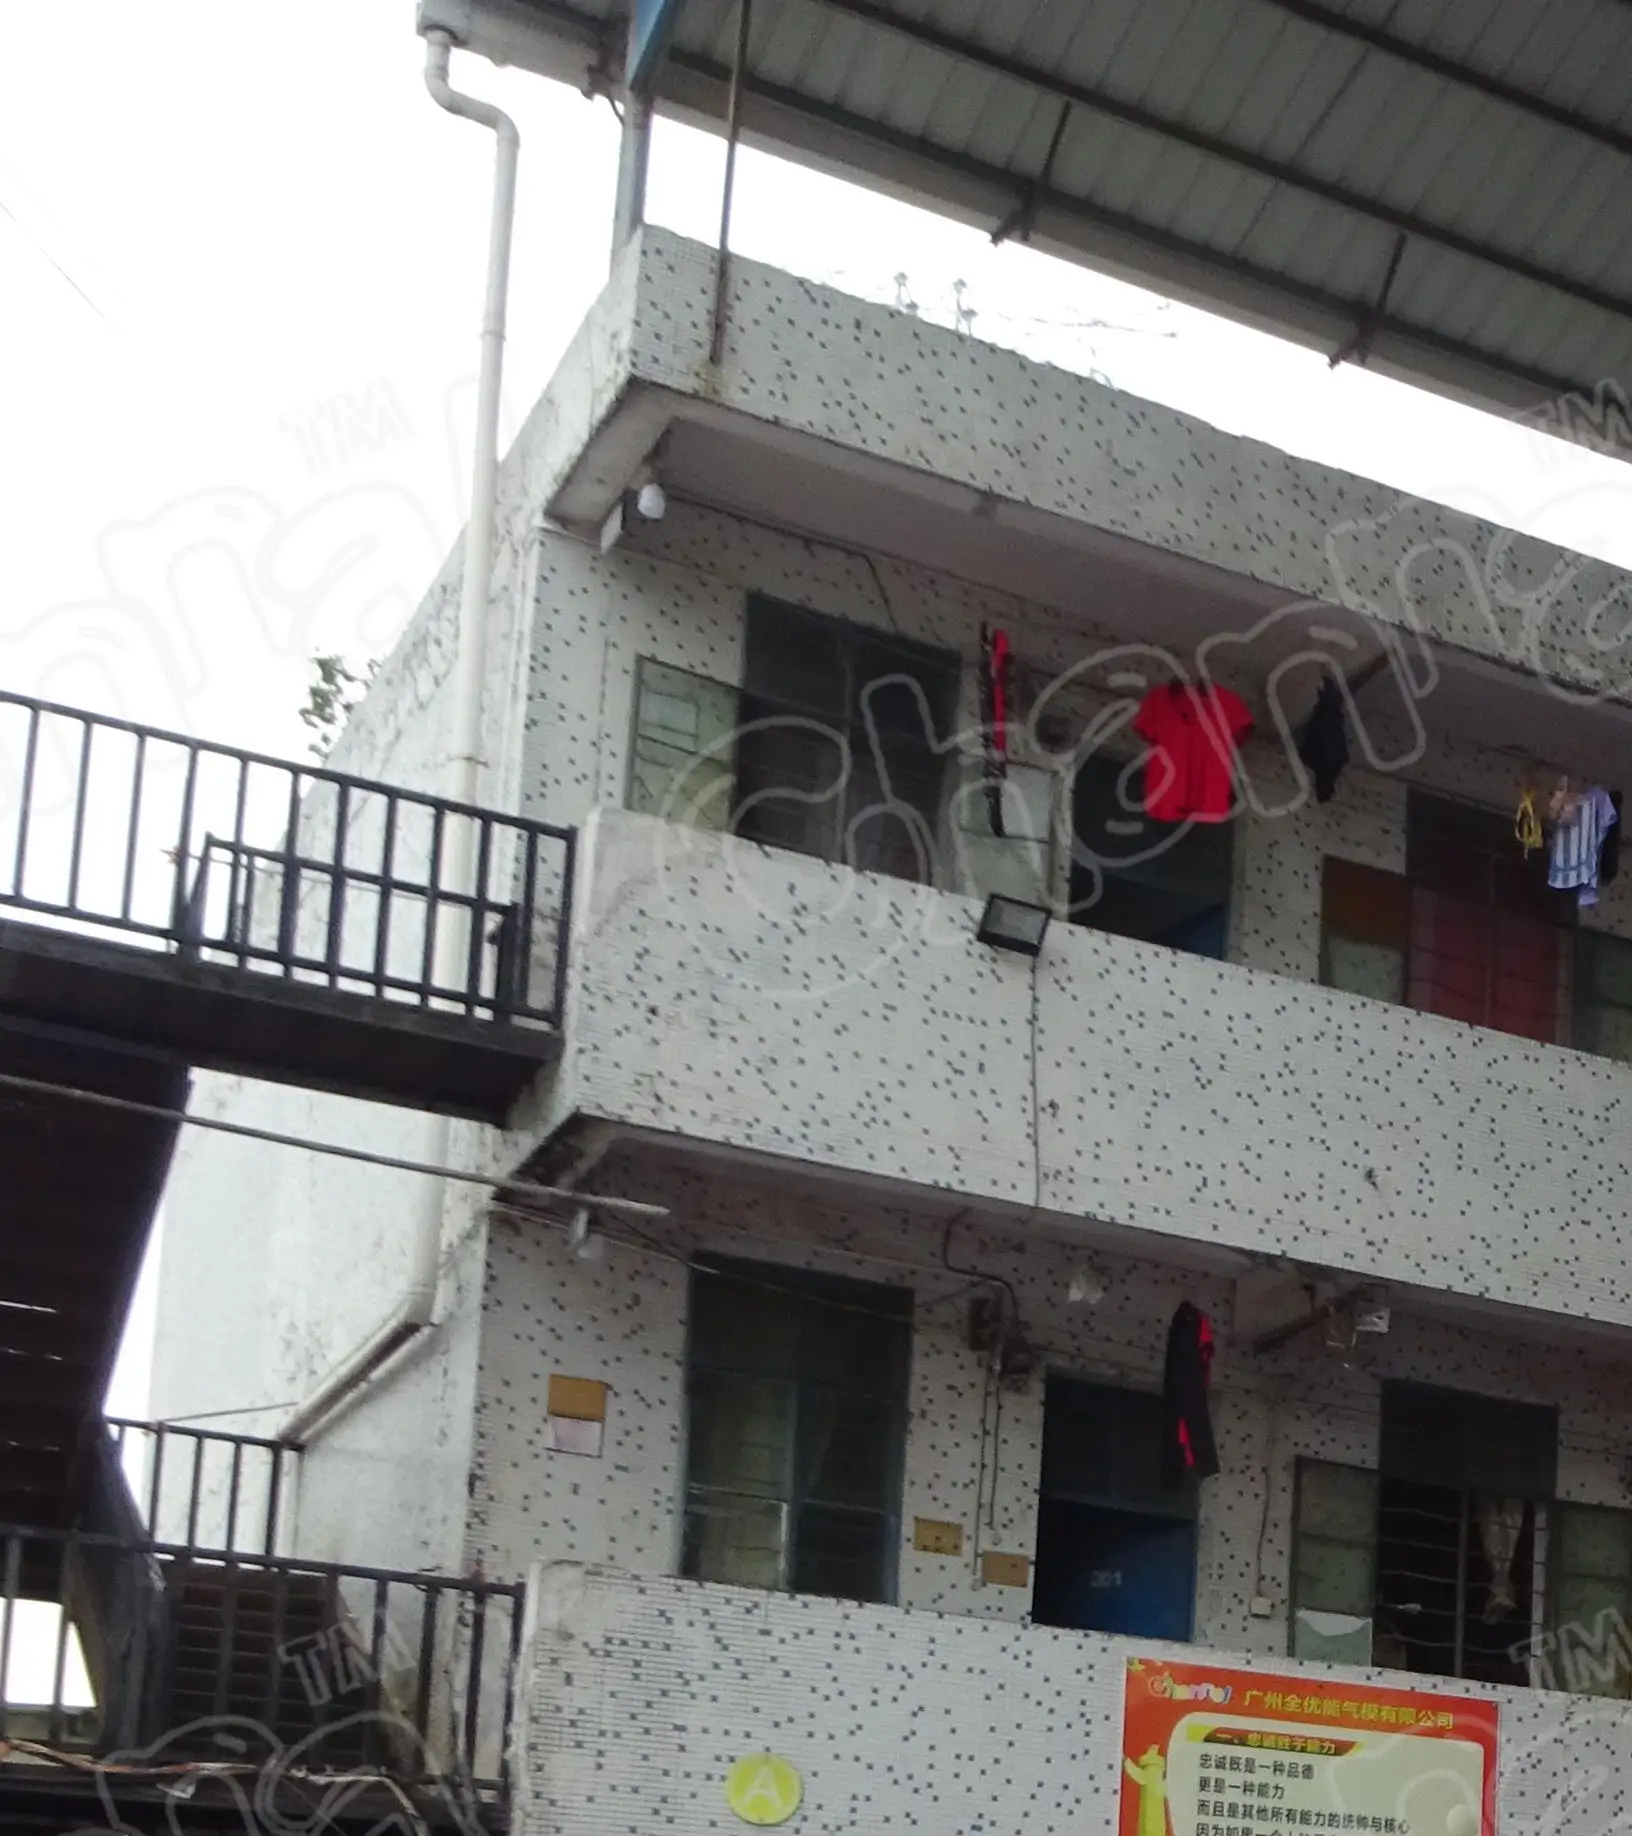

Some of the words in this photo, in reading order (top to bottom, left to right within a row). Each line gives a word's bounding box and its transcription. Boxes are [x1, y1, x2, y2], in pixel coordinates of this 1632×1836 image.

[1244, 1688, 1454, 1730] 广州全优能气模有限公司
[1199, 1753, 1315, 1780] 忠诚既是一种品德
[742, 1765, 785, 1812] A
[1199, 1776, 1285, 1800] 更是一种能力
